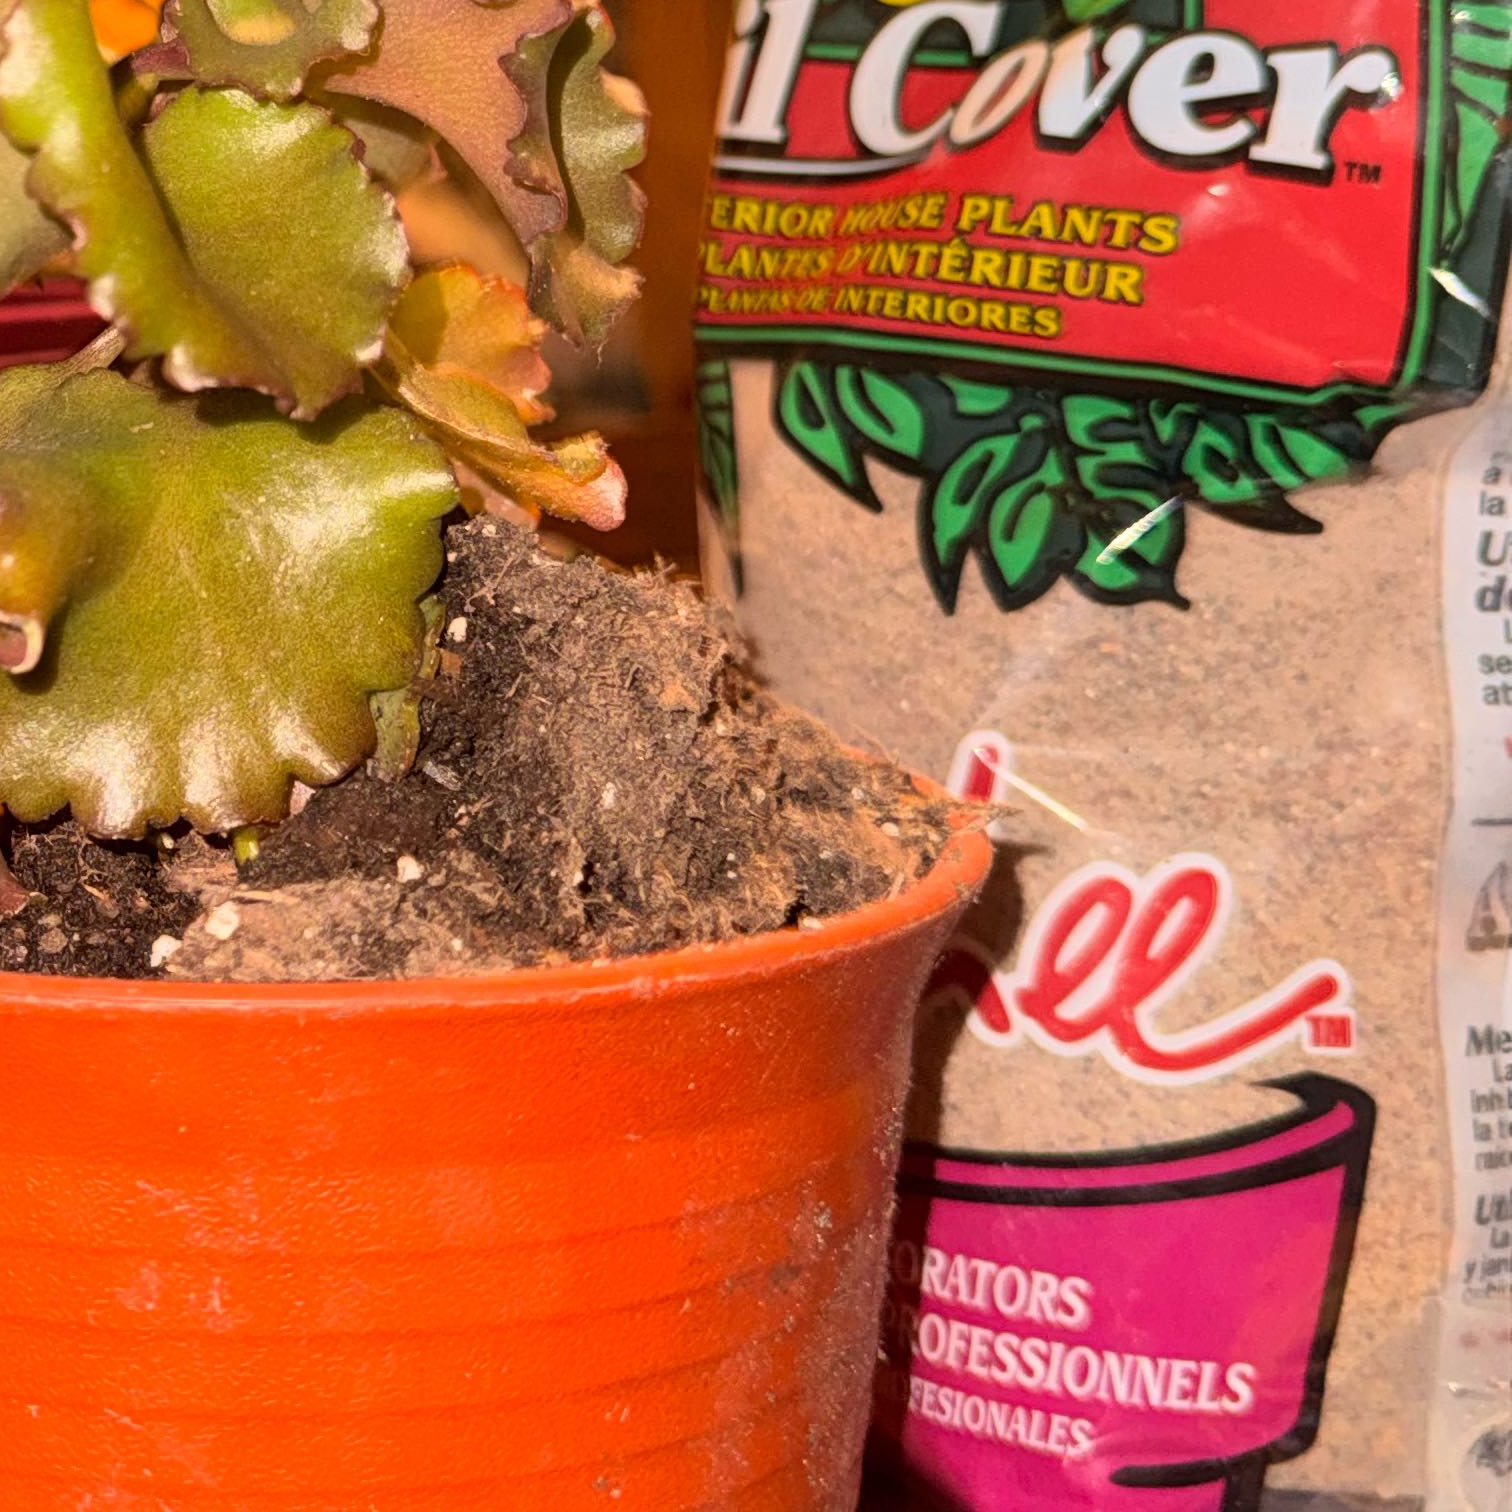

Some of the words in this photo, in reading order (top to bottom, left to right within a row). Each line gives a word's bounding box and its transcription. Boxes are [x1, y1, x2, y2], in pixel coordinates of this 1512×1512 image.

[838, 191, 948, 237] HOUSE
[957, 194, 1180, 256] PLANTS
[698, 240, 834, 280] LANTES
[836, 237, 1143, 306] D'INTÉRIEUR
[699, 285, 792, 314] LANTAS
[833, 285, 1061, 338] INTERIORES
[892, 1304, 1258, 1416] OFESSIONNELS
